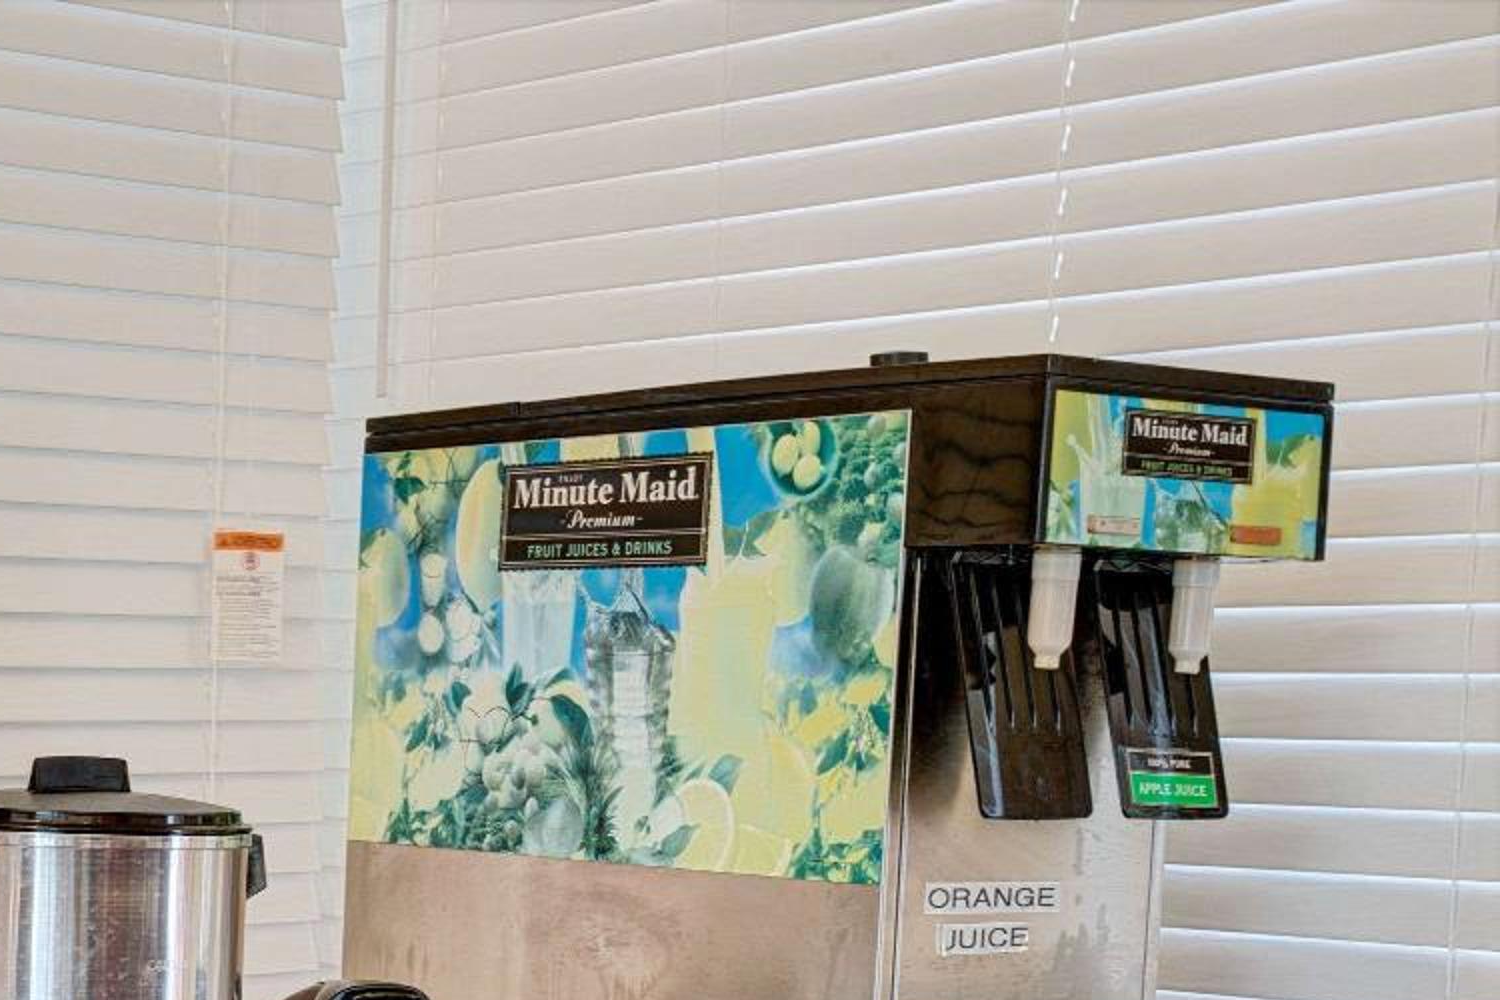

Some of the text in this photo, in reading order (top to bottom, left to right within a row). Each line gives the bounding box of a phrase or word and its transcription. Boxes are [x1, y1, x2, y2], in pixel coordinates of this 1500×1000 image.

[1132, 416, 1248, 447] Minute Maid
[514, 466, 699, 509] Minute Maid
[527, 543, 563, 558] FRUIT
[566, 543, 608, 557] JUICES
[625, 539, 673, 555] DRINKS
[1139, 782, 1208, 797] APPLE JUICE
[927, 887, 1056, 909] ORANGE
[946, 927, 1028, 950] JUICE
